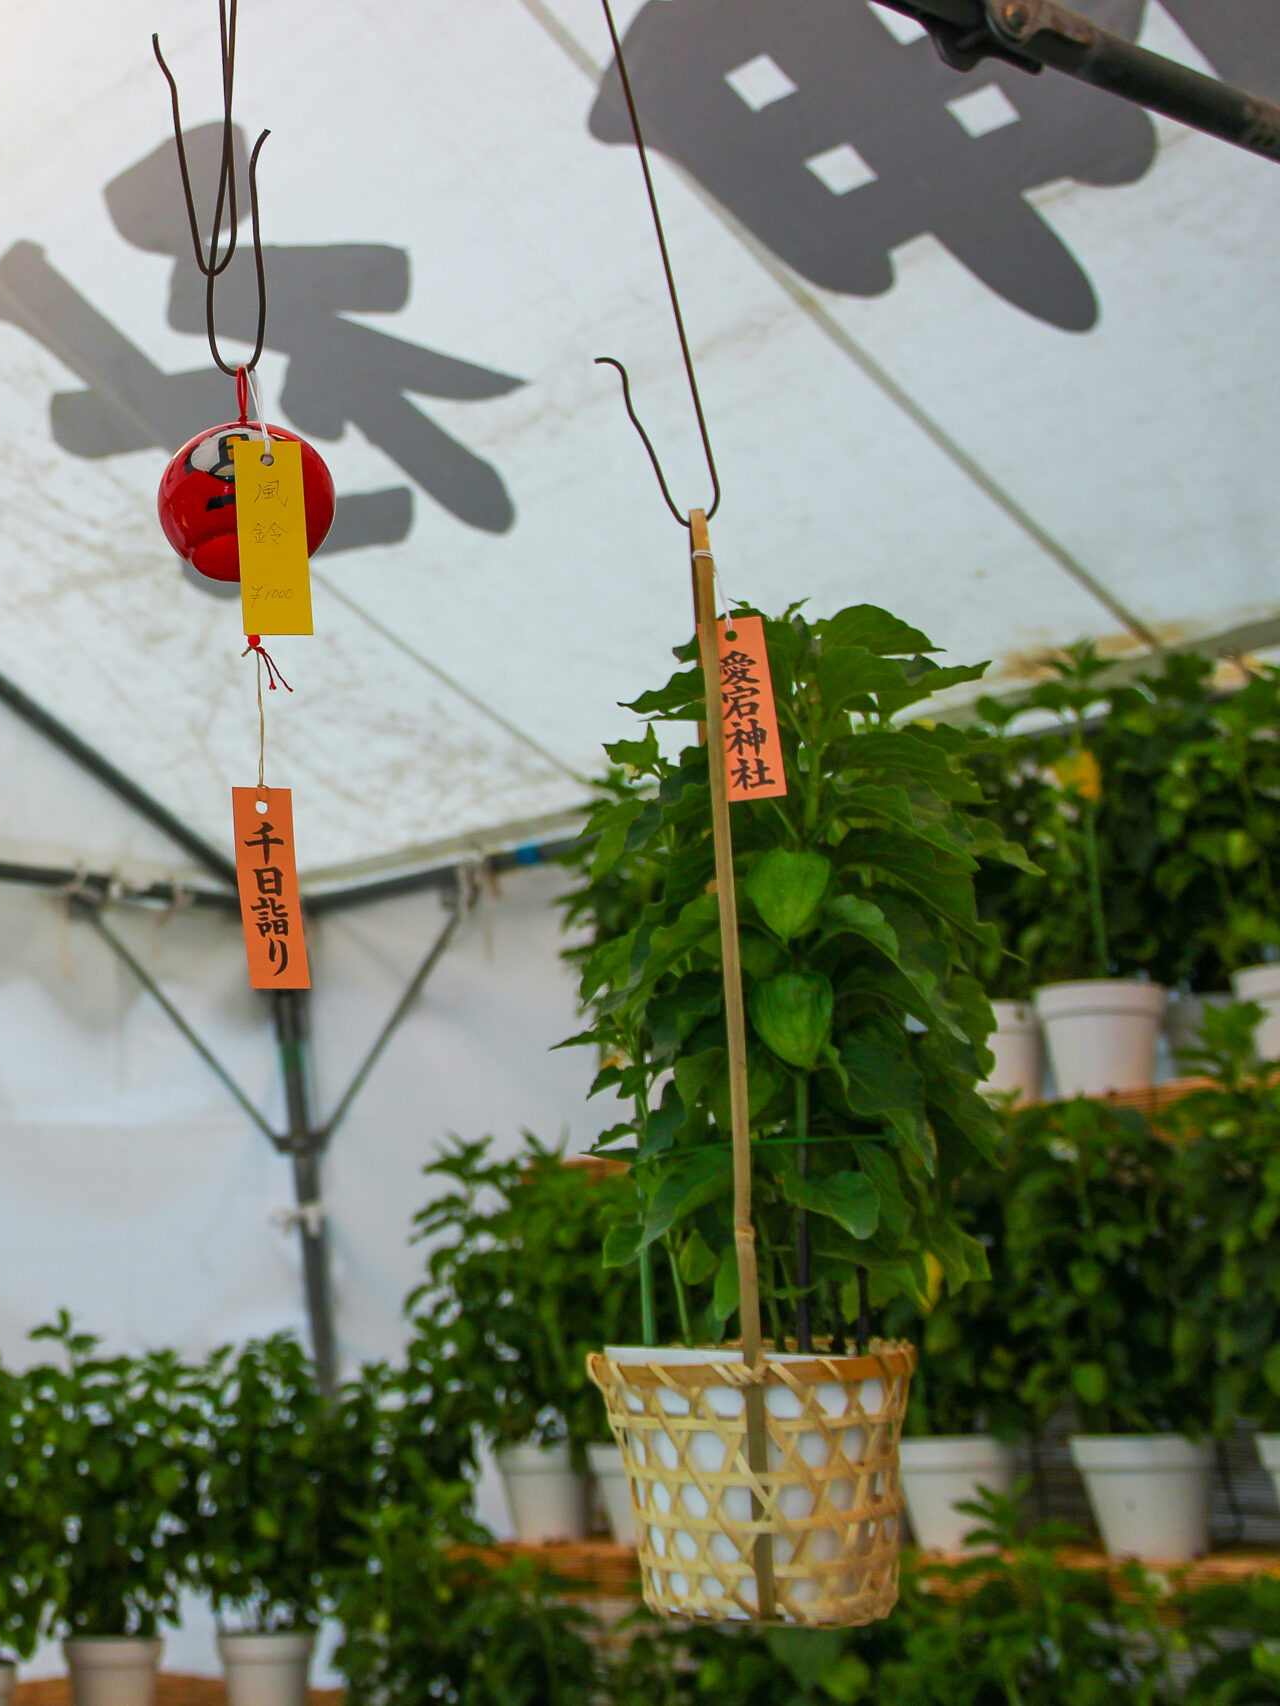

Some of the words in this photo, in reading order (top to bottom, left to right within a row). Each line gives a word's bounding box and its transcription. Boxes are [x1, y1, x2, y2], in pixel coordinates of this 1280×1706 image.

[719, 650, 776, 791] 愛宕神社
[244, 821, 289, 977] 千日詣り
